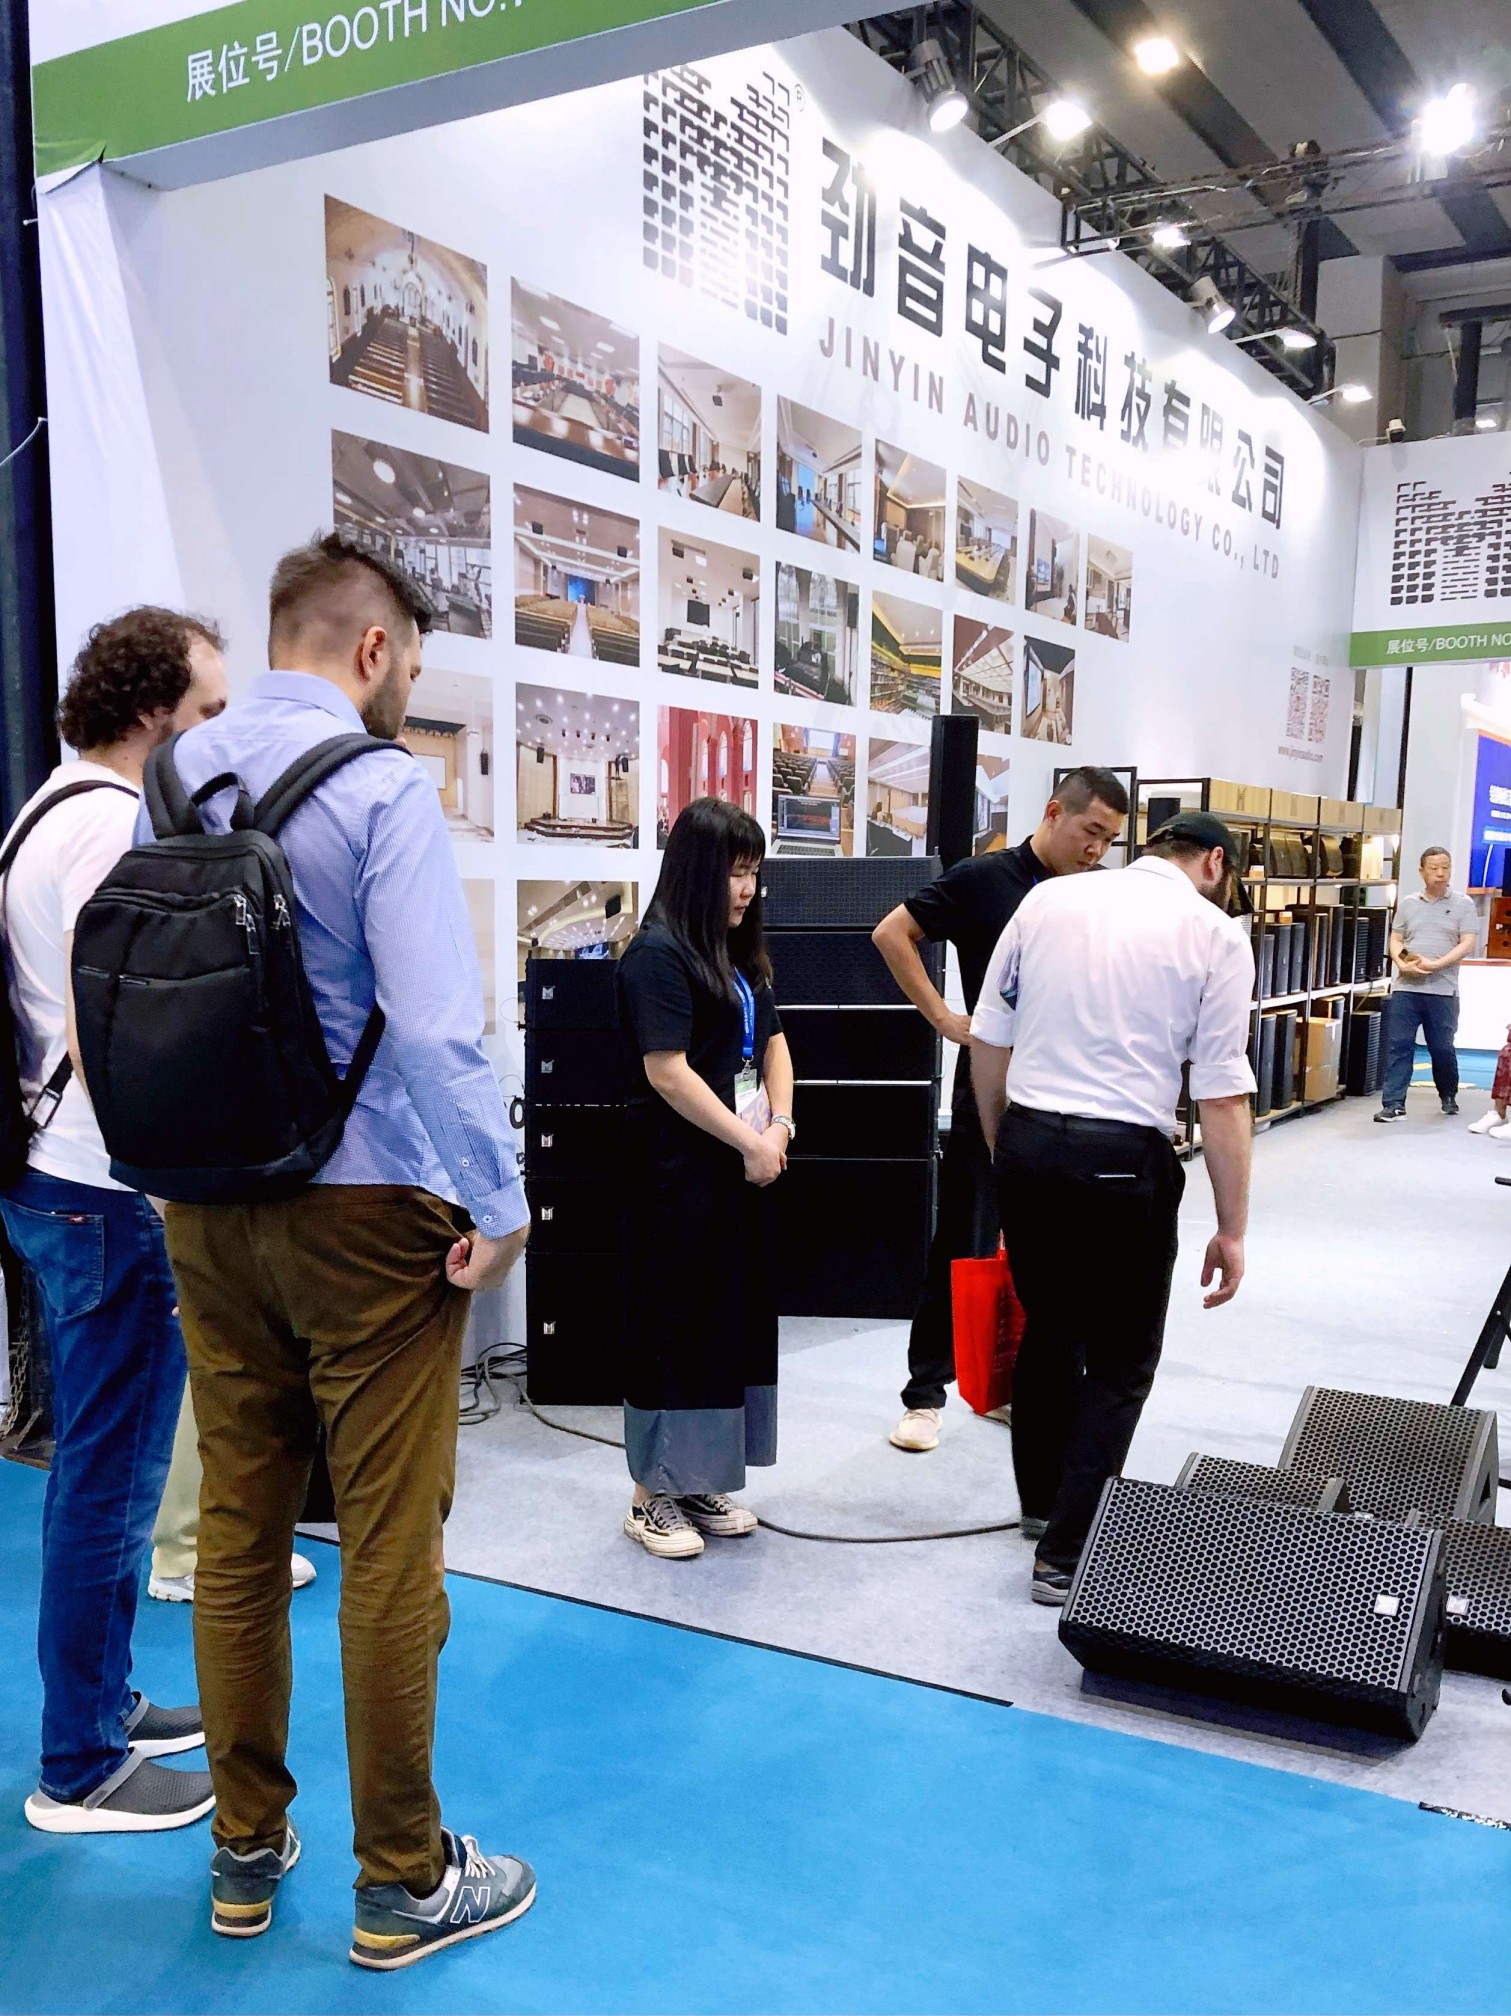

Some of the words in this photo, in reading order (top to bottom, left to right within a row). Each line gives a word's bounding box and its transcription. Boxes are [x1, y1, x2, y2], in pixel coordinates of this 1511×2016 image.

[187, 0, 428, 103] 展位号/BOOTH
[821, 136, 1285, 530] 劲音电子科技有限公司
[818, 316, 944, 415] JINYIN
[963, 391, 1050, 467] AUDIO
[1065, 443, 1203, 543] TECHNOLOGY
[1212, 522, 1245, 570] CO.,
[1253, 543, 1280, 580] LTD
[1386, 634, 1488, 655] 展位号/BOOTH
[449, 1886, 490, 1924] N
